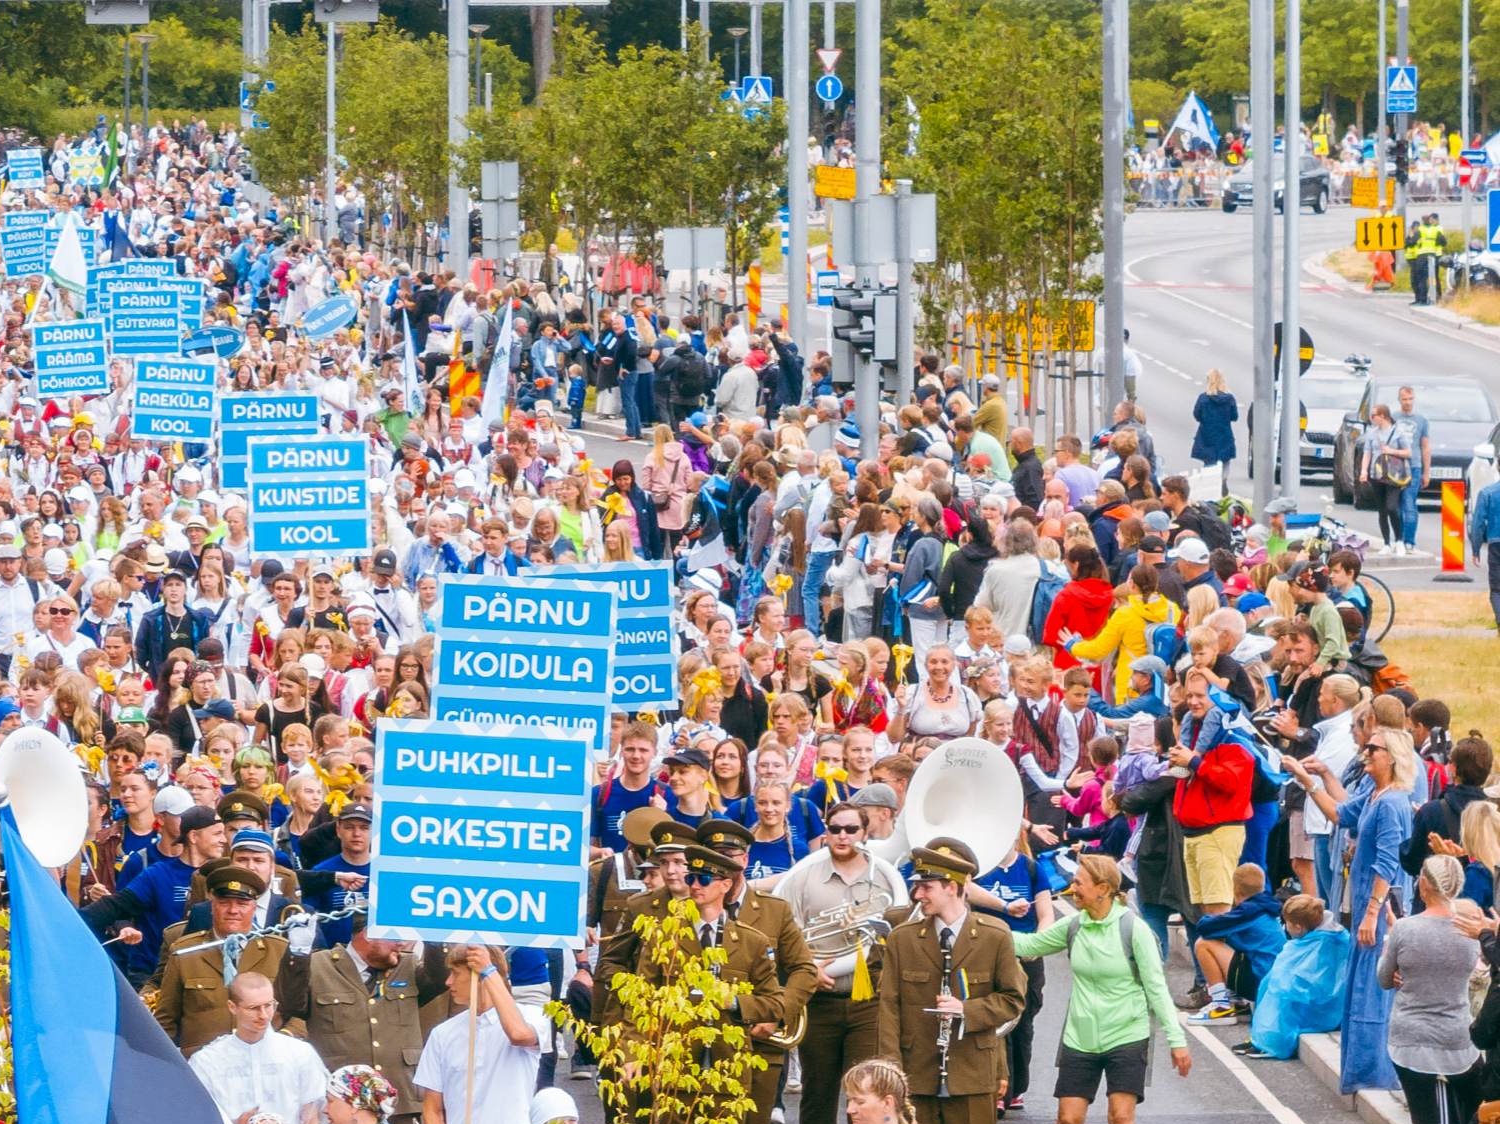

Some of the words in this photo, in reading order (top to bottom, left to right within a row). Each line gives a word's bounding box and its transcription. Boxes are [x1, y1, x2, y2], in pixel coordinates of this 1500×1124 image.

[7, 230, 44, 242] PÄRNU
[16, 262, 44, 273] KOOL
[120, 293, 171, 307] PÄRNU
[115, 315, 176, 329] SÜTEVAKA
[42, 327, 95, 343] PÄRNU
[46, 350, 96, 367] RÄÄMA
[40, 373, 104, 390] PÕHIKOOL
[145, 365, 206, 383] PÄRNU
[139, 390, 210, 410] RAEKÜLA
[232, 401, 307, 421] PÄRNU
[150, 418, 194, 434] KOOL
[267, 447, 350, 469] PÄRNU
[257, 485, 360, 507] KUNSTIDE
[280, 525, 340, 545] KOOL
[463, 591, 591, 627] PÄRNU
[453, 649, 594, 684] KOIDULA
[612, 674, 666, 696] OOL
[395, 746, 574, 779] PUHKPILLI-
[390, 813, 573, 853] ORKESTER
[409, 884, 547, 923] SAXON
